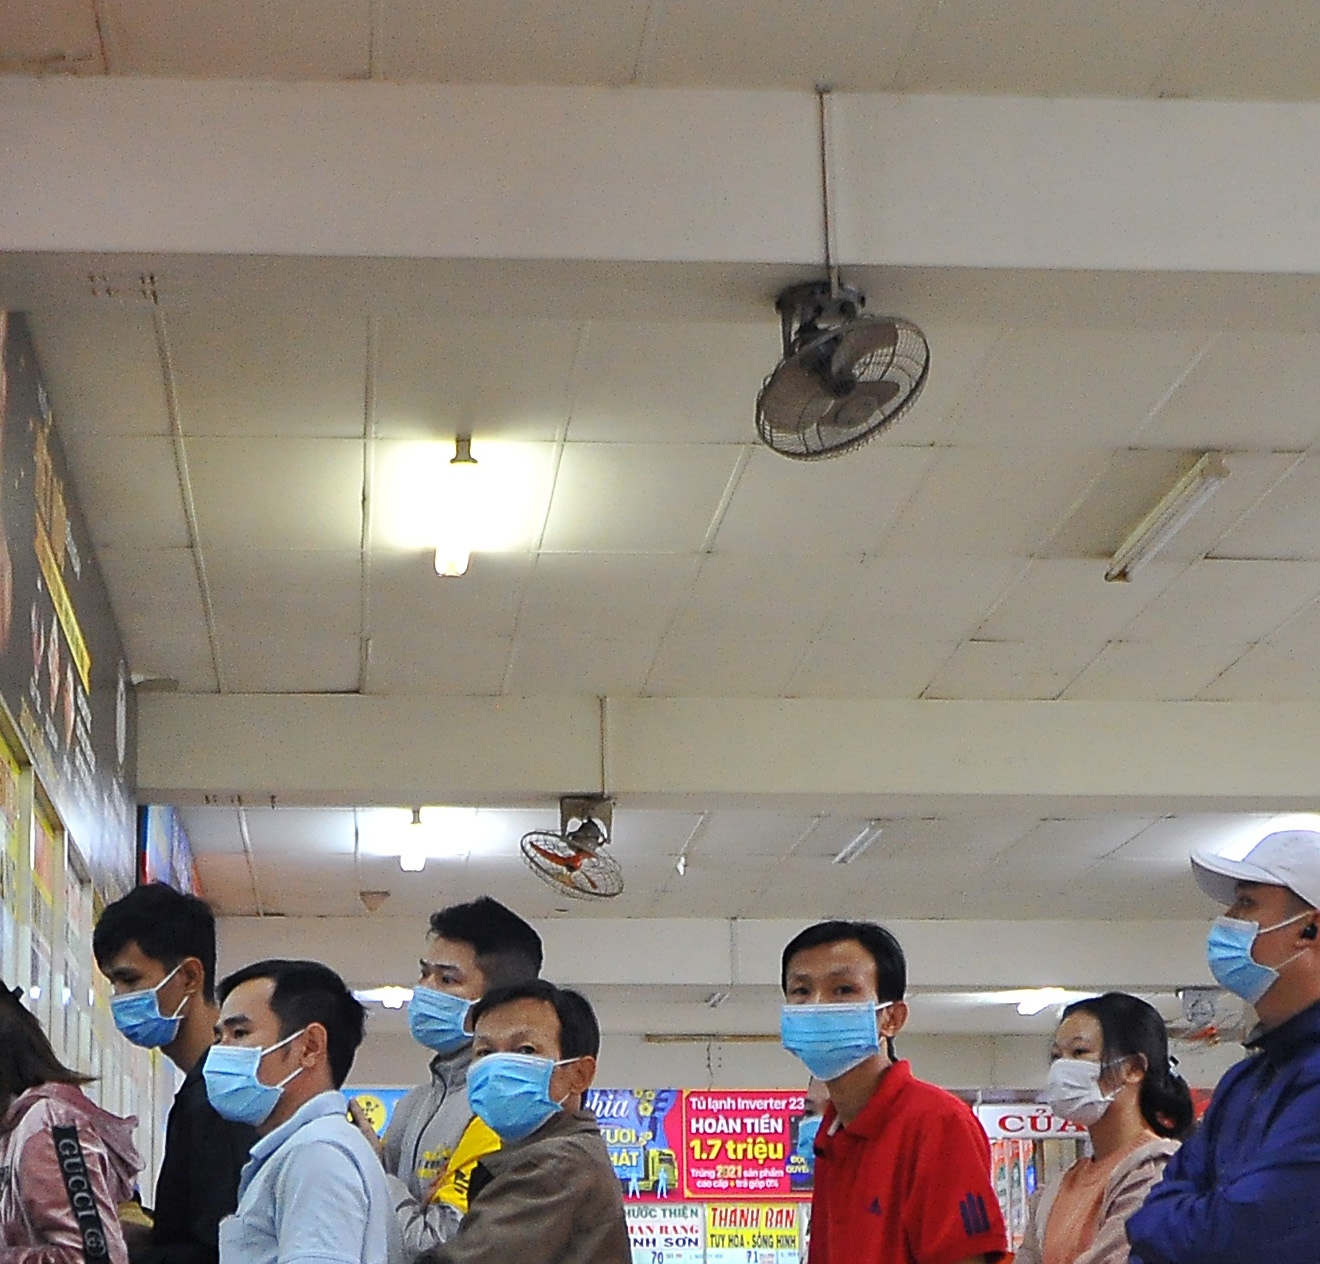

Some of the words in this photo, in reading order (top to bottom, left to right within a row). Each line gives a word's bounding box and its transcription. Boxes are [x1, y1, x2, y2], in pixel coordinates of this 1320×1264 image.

[690, 1096, 706, 1110] Tủ
[708, 1097, 736, 1112] lạnh
[737, 1097, 788, 1110] Inverter
[789, 1097, 805, 1110] 23
[690, 1114, 741, 1134] HOÀN
[689, 1139, 722, 1160] 1.7
[725, 1137, 784, 1164] triệu
[660, 1205, 698, 1220] THIỆN
[664, 1236, 698, 1248] SƠN
[710, 1234, 726, 1248] TUY
[651, 1251, 664, 1264] 70
[747, 1250, 759, 1264] 71
